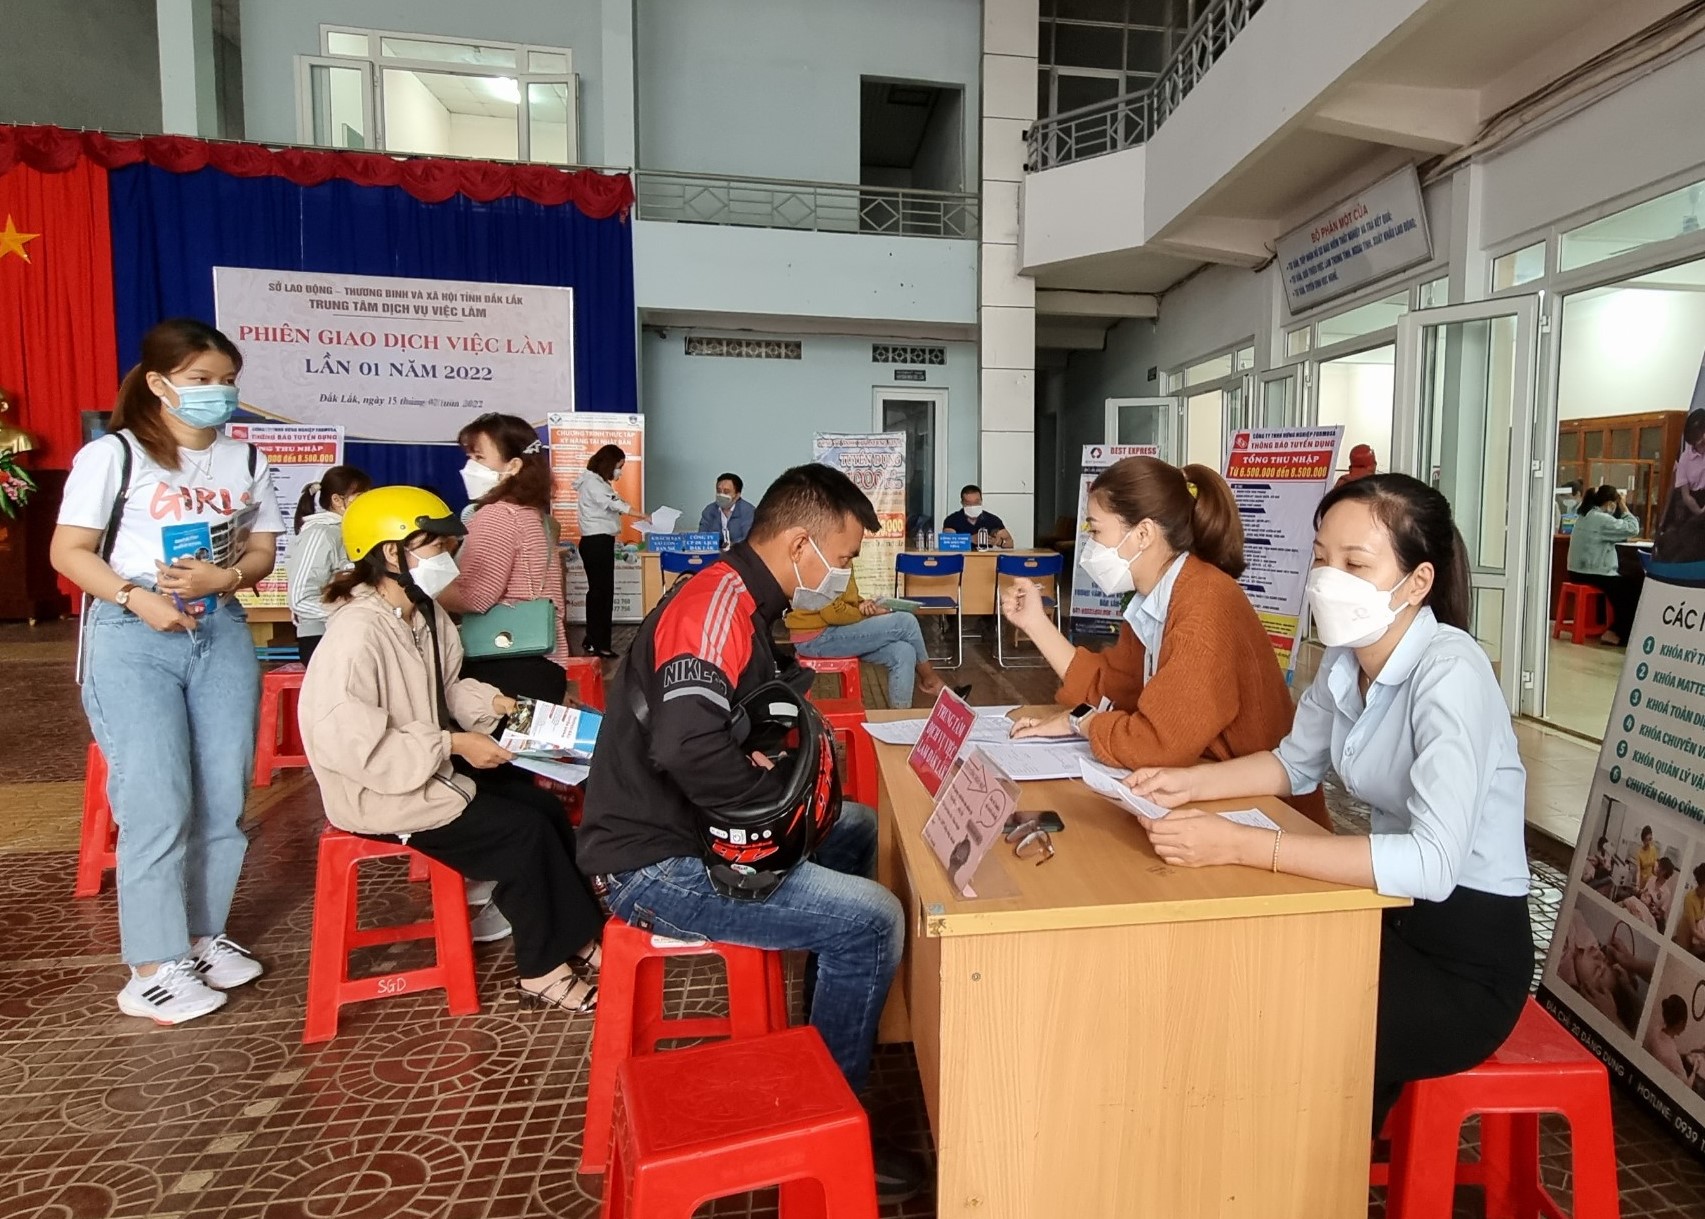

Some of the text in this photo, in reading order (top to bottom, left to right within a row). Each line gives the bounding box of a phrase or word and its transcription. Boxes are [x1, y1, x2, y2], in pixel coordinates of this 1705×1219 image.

[268, 281, 282, 292] SỞ
[284, 284, 303, 293] LAO
[306, 284, 333, 295] ĐỘNG
[344, 287, 382, 298] THƯƠNG
[385, 289, 409, 299] BINH
[411, 289, 424, 300] VÀ
[426, 290, 439, 301] XÃ
[442, 291, 458, 303] HỘI
[460, 291, 481, 303] TỈNH
[309, 299, 487, 318] TRUNG TÂM DỊCH VỤ VIỆC LÀM
[239, 323, 554, 356] PHIÊN GIAO DỊCH VIỆC LÀM
[305, 352, 493, 381] LẦN 01 NĂM 2022
[362, 395, 385, 406] ngày
[388, 396, 398, 405] 15
[1128, 446, 1157, 456] EXPRESS
[1251, 438, 1335, 449] THÔNG BÁO TUYỂN DỤNG
[1243, 453, 1320, 465] TỔNG THU NHẬP
[1229, 465, 1328, 478] Từ 6.500.000 đến 8.500.000
[1662, 601, 1698, 630] CÁC
[1659, 643, 1683, 661] KHÓA
[1683, 648, 1698, 664] KỸ
[1652, 671, 1677, 688] KHÓA
[1638, 724, 1662, 742] KHÓA
[1661, 732, 1698, 756] CHUYÊN
[1632, 750, 1655, 769] KHÓA
[1655, 759, 1680, 779] QUẢN
[1679, 767, 1691, 783] LÝ
[1657, 790, 1679, 810] GIAO
[1678, 799, 1705, 821] CÔNG
[377, 977, 407, 994] SGD
[1674, 1116, 1698, 1144] 0939
